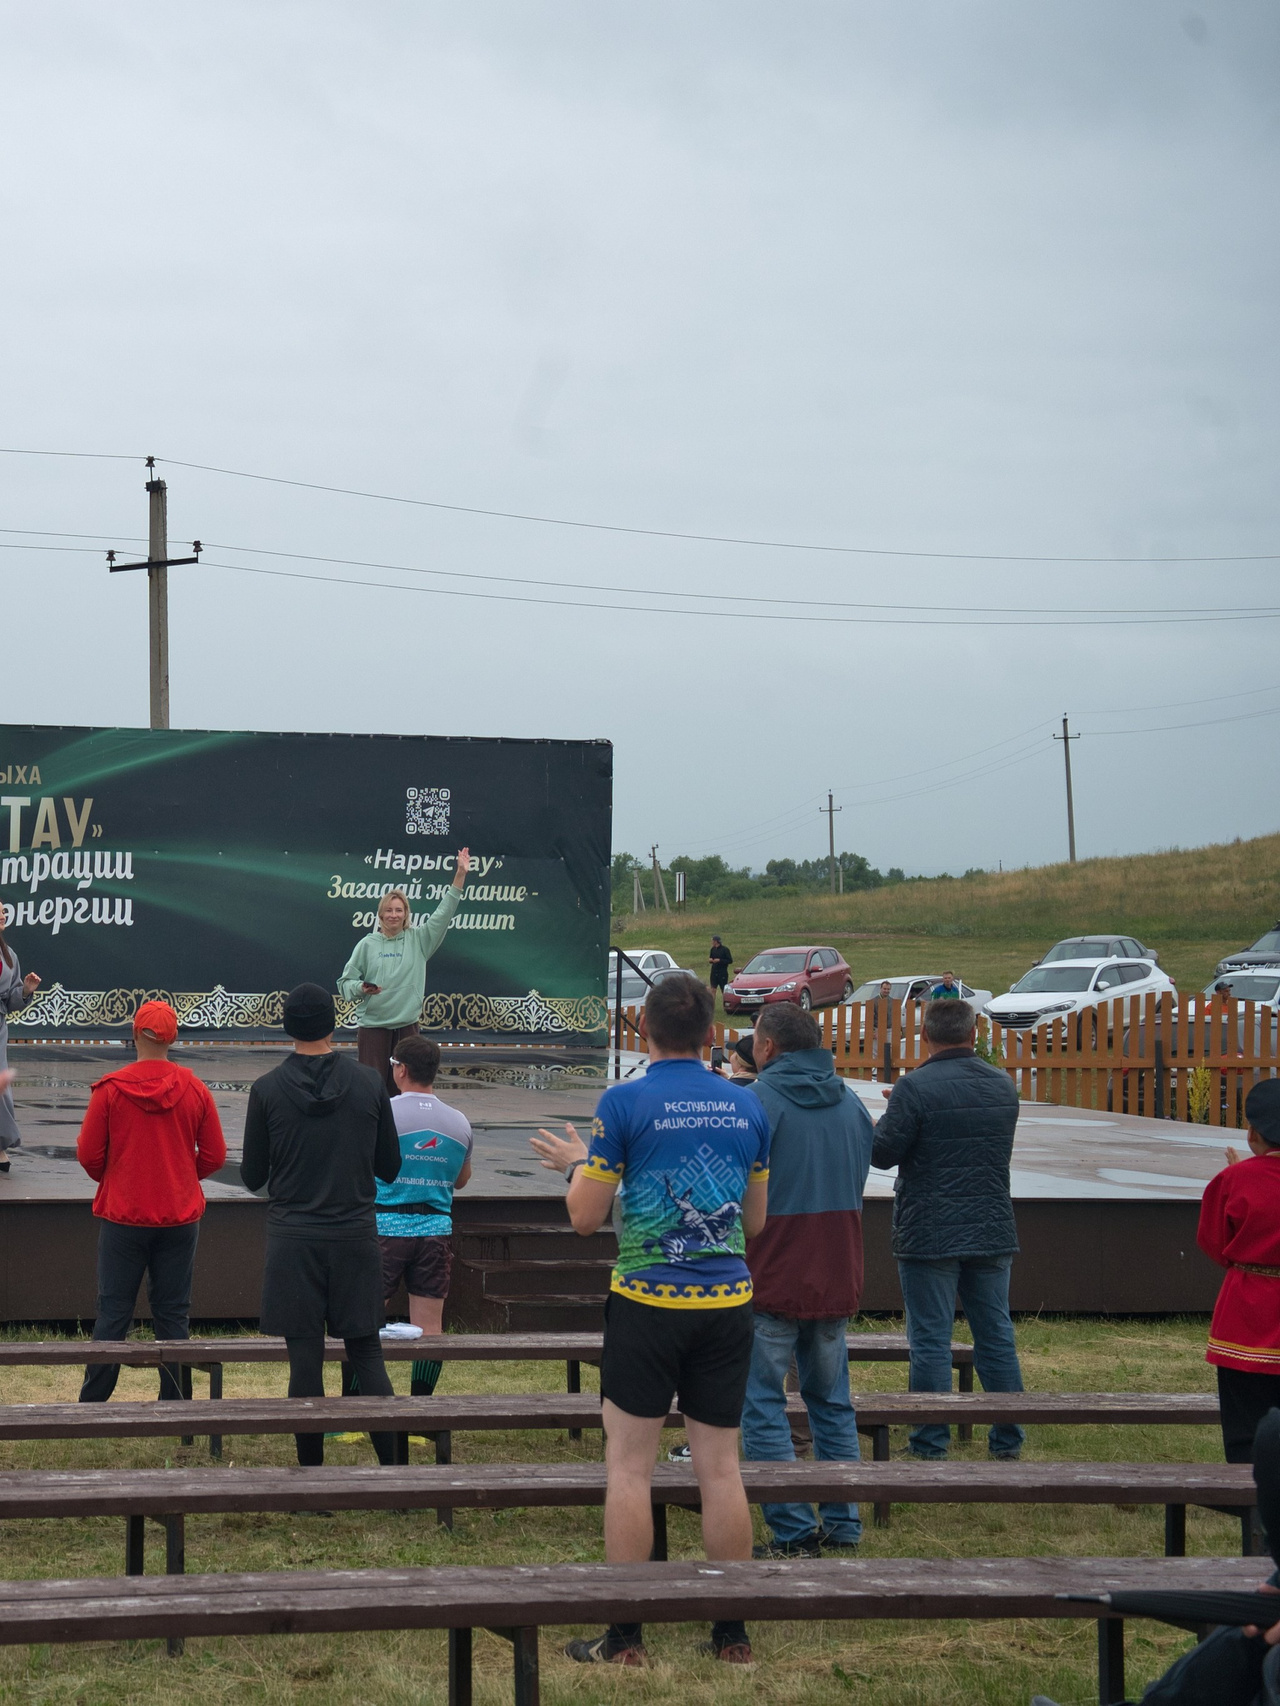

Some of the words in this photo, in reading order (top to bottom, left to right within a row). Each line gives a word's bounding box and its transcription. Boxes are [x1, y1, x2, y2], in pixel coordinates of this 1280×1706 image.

[364, 848, 503, 877] «Нарысау»
[426, 883, 527, 902] жлание
[664, 1101, 736, 1113] РЕСПУБЛИКА
[654, 1116, 749, 1131] БАШКОРТОСТАН
[405, 1155, 448, 1164] РОСКОСМОС
